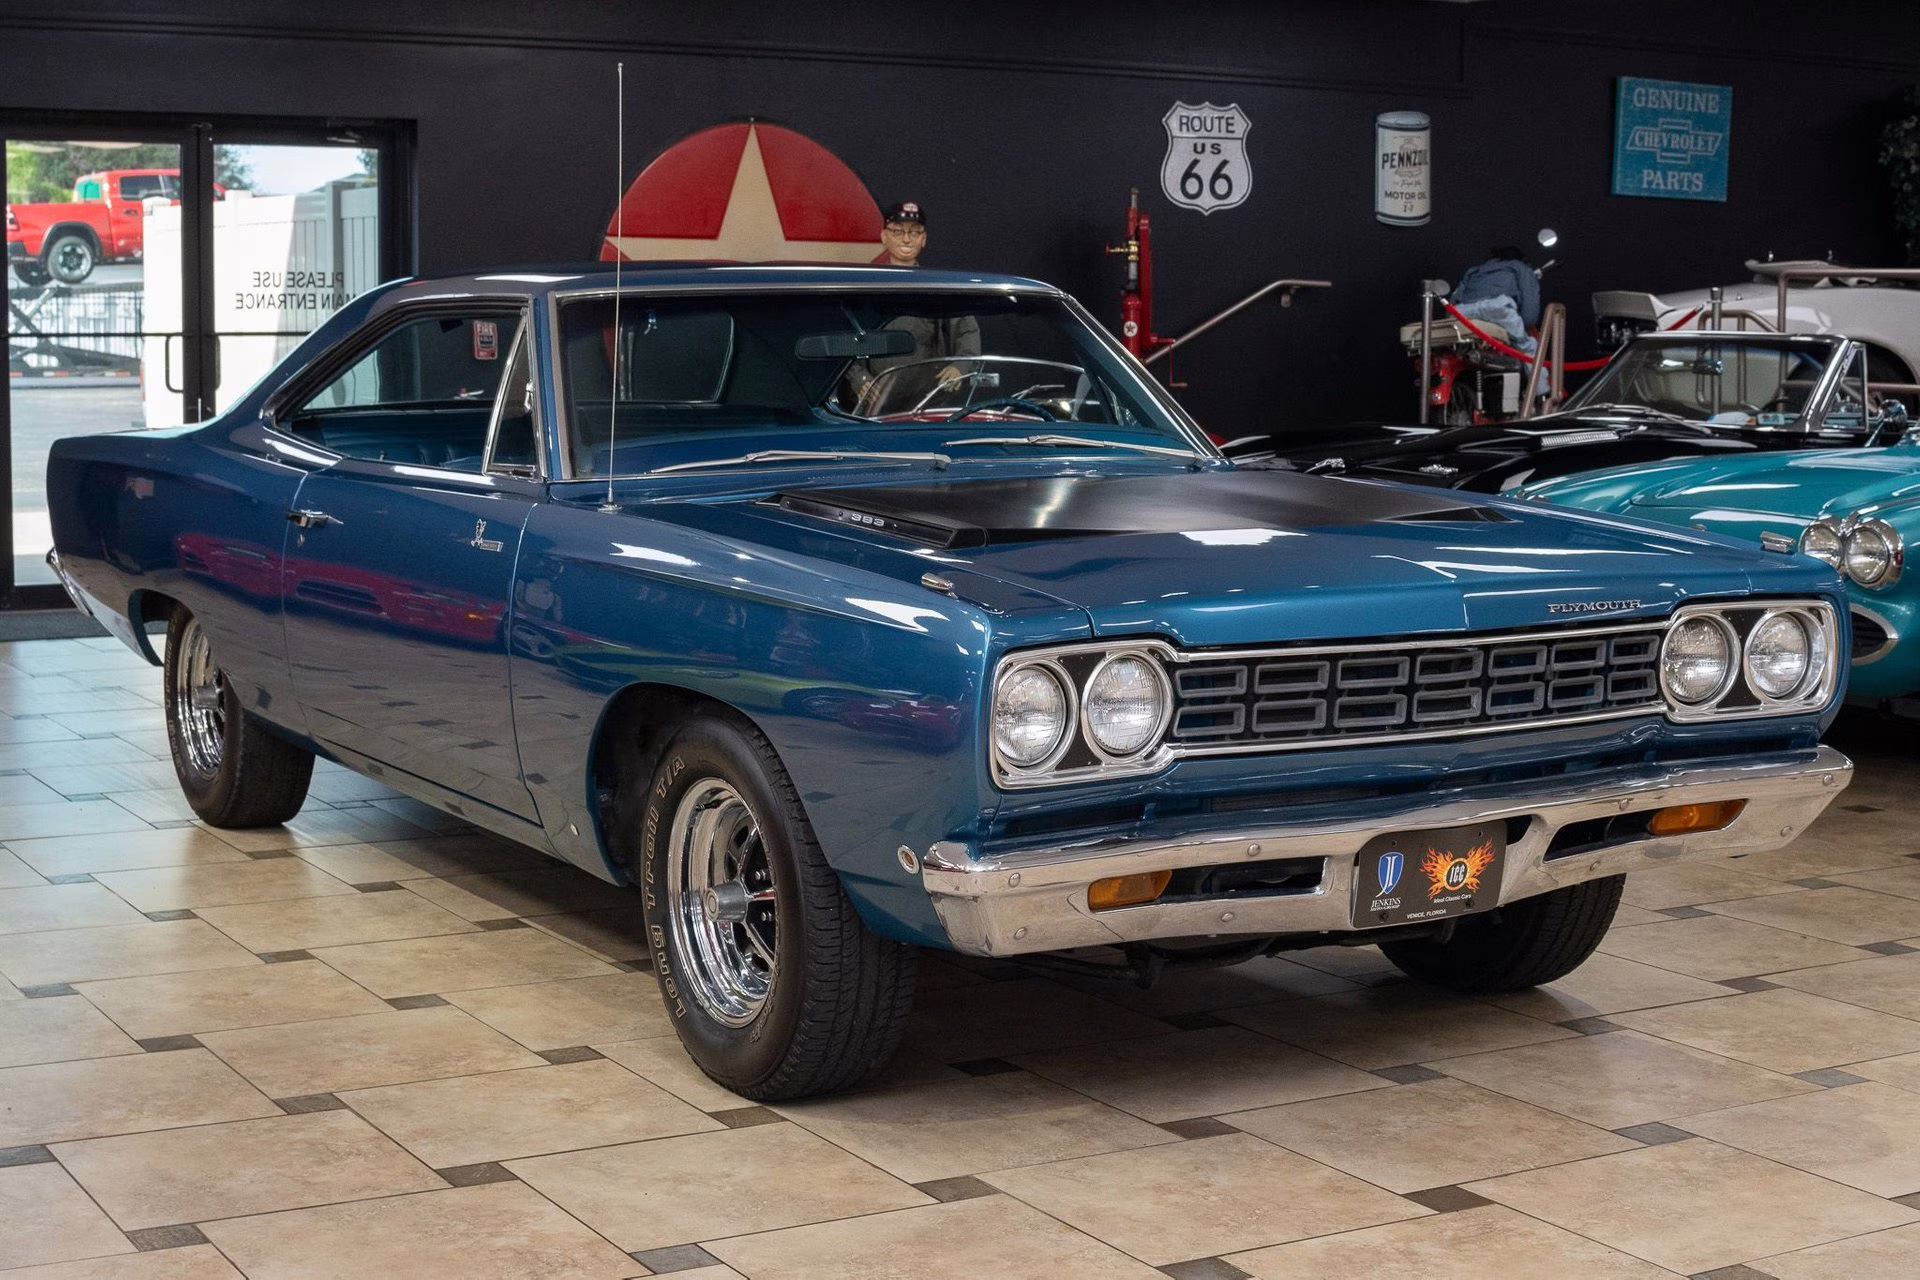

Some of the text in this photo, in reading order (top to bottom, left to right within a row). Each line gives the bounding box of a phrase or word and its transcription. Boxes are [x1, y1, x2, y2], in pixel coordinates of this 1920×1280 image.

[1632, 87, 1720, 113] GENUINE
[1179, 115, 1236, 134] ROUTE
[1193, 142, 1222, 155] US
[1634, 129, 1716, 152] CHEVROLET
[1180, 158, 1233, 200] 66
[1641, 169, 1704, 192] PARTS
[1384, 190, 1416, 200] MOTOR
[851, 513, 885, 527] 383
[1547, 599, 1641, 613] PLYMOUTH
[645, 806, 660, 910] Trail
[1371, 897, 1401, 908] JENKINS
[651, 925, 687, 1018] Long
